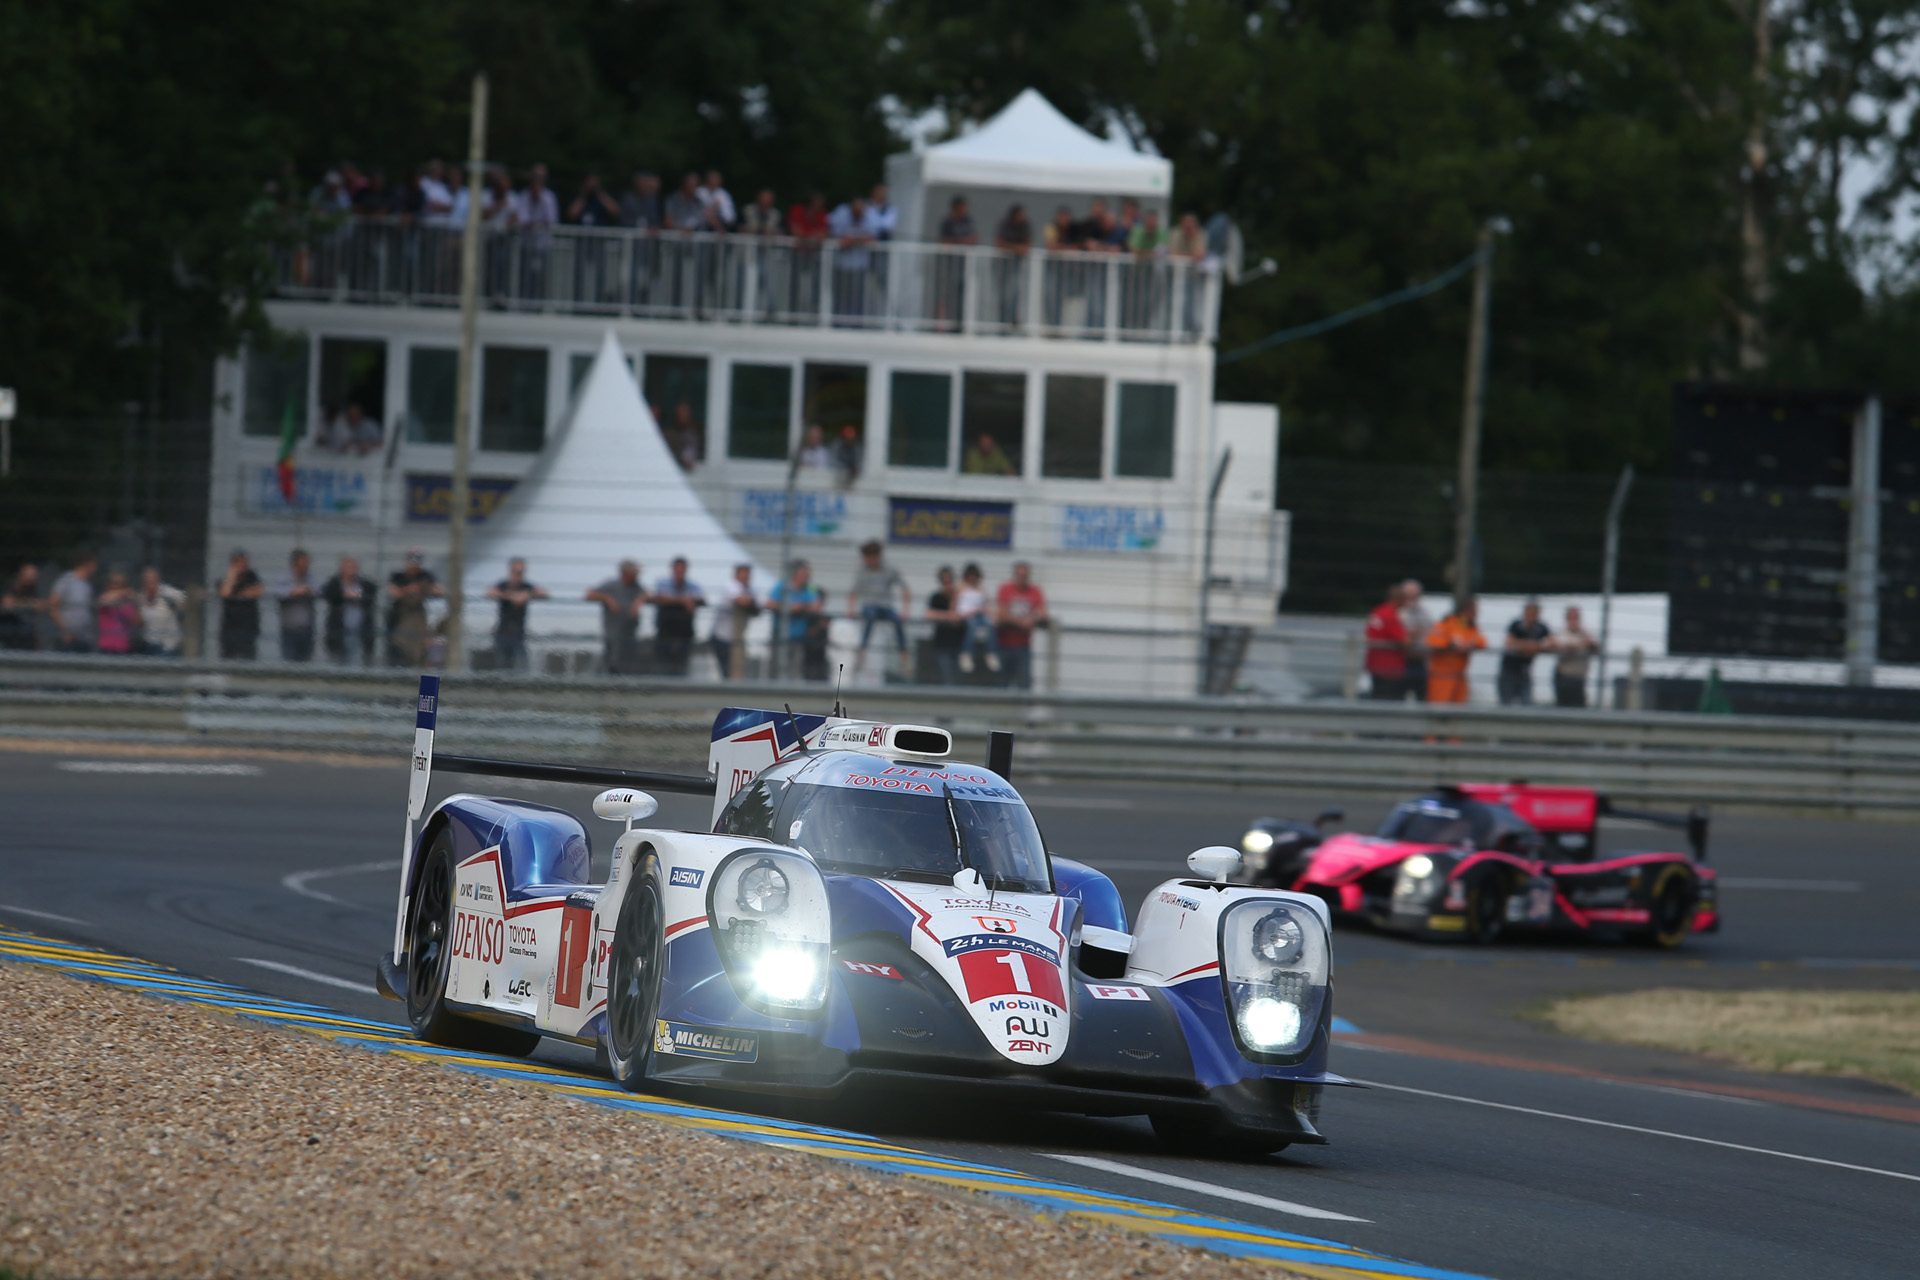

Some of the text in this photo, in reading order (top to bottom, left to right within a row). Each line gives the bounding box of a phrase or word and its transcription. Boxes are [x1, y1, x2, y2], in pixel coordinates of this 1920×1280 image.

[879, 767, 989, 785] DENSO
[844, 774, 1019, 800] TOYOTA HYBRID
[671, 870, 701, 885] AISIN
[940, 898, 1029, 913] TOYOTA
[1159, 892, 1178, 905] TOYOTA
[453, 912, 504, 965] DENSO
[509, 925, 537, 946] TOYOTA
[562, 919, 574, 995] 1
[1012, 940, 1057, 960] MANS
[843, 960, 891, 976] HY
[996, 951, 1032, 994] 1
[508, 979, 531, 998] WEC
[1095, 986, 1139, 998] P1
[989, 999, 1040, 1012] Mobil
[675, 1030, 755, 1053] MICHELIN
[1008, 1039, 1052, 1055] ZENT
